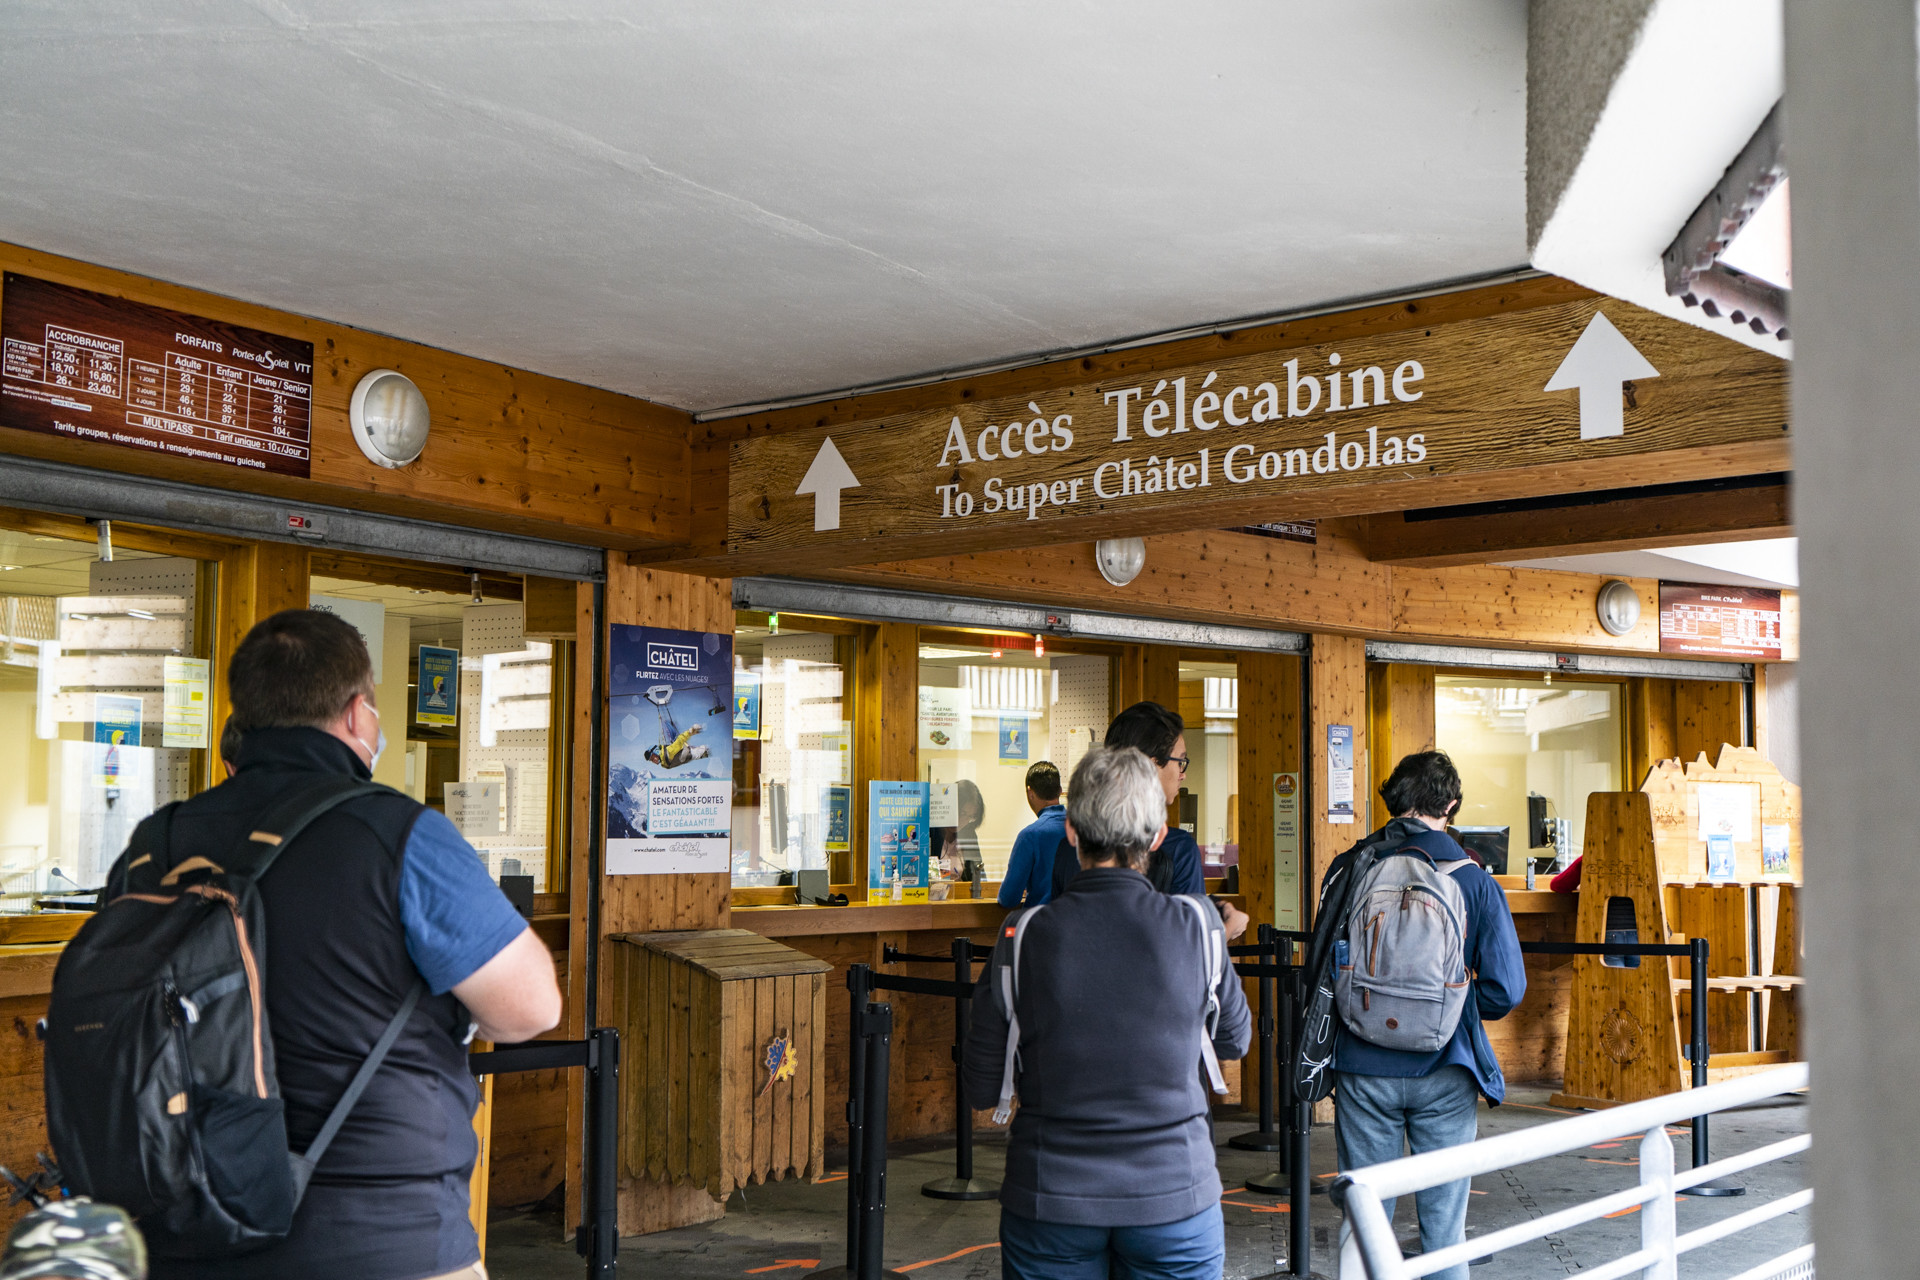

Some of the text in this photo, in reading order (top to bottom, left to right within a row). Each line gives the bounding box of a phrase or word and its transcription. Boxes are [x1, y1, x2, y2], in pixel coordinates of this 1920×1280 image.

[48, 330, 120, 353] ACCROBRANCHE
[176, 332, 311, 374] FORFAITS Portes du Soleil VTT
[140, 366, 159, 374] HEURES
[175, 356, 201, 370] Adulte
[217, 366, 243, 380] Enfant
[254, 375, 277, 388] Jeune
[283, 382, 307, 394] Senior
[141, 388, 156, 396] JOURS
[937, 353, 1425, 468] Accès Télécabine
[143, 416, 194, 435] MULTIPASS
[215, 431, 233, 443] Tarif
[235, 437, 261, 449] unique
[54, 421, 266, 468] Tarifs groupes, réservations & renseignements aux guichets
[936, 426, 1426, 520] To Super Châtel Gondolas
[650, 648, 695, 667] CHÂTEL
[636, 671, 659, 680] FLIRTEZ
[660, 672, 674, 681] AVEC
[675, 674, 684, 682] LES
[653, 786, 687, 794] AMATEUR
[653, 796, 724, 805] SENSATIONS FORTES
[895, 797, 903, 805] LES
[653, 807, 718, 817] LE FANTASTICABLE
[879, 807, 889, 818] QUI
[891, 806, 918, 817] SAUVENT
[653, 820, 672, 828] C'EST
